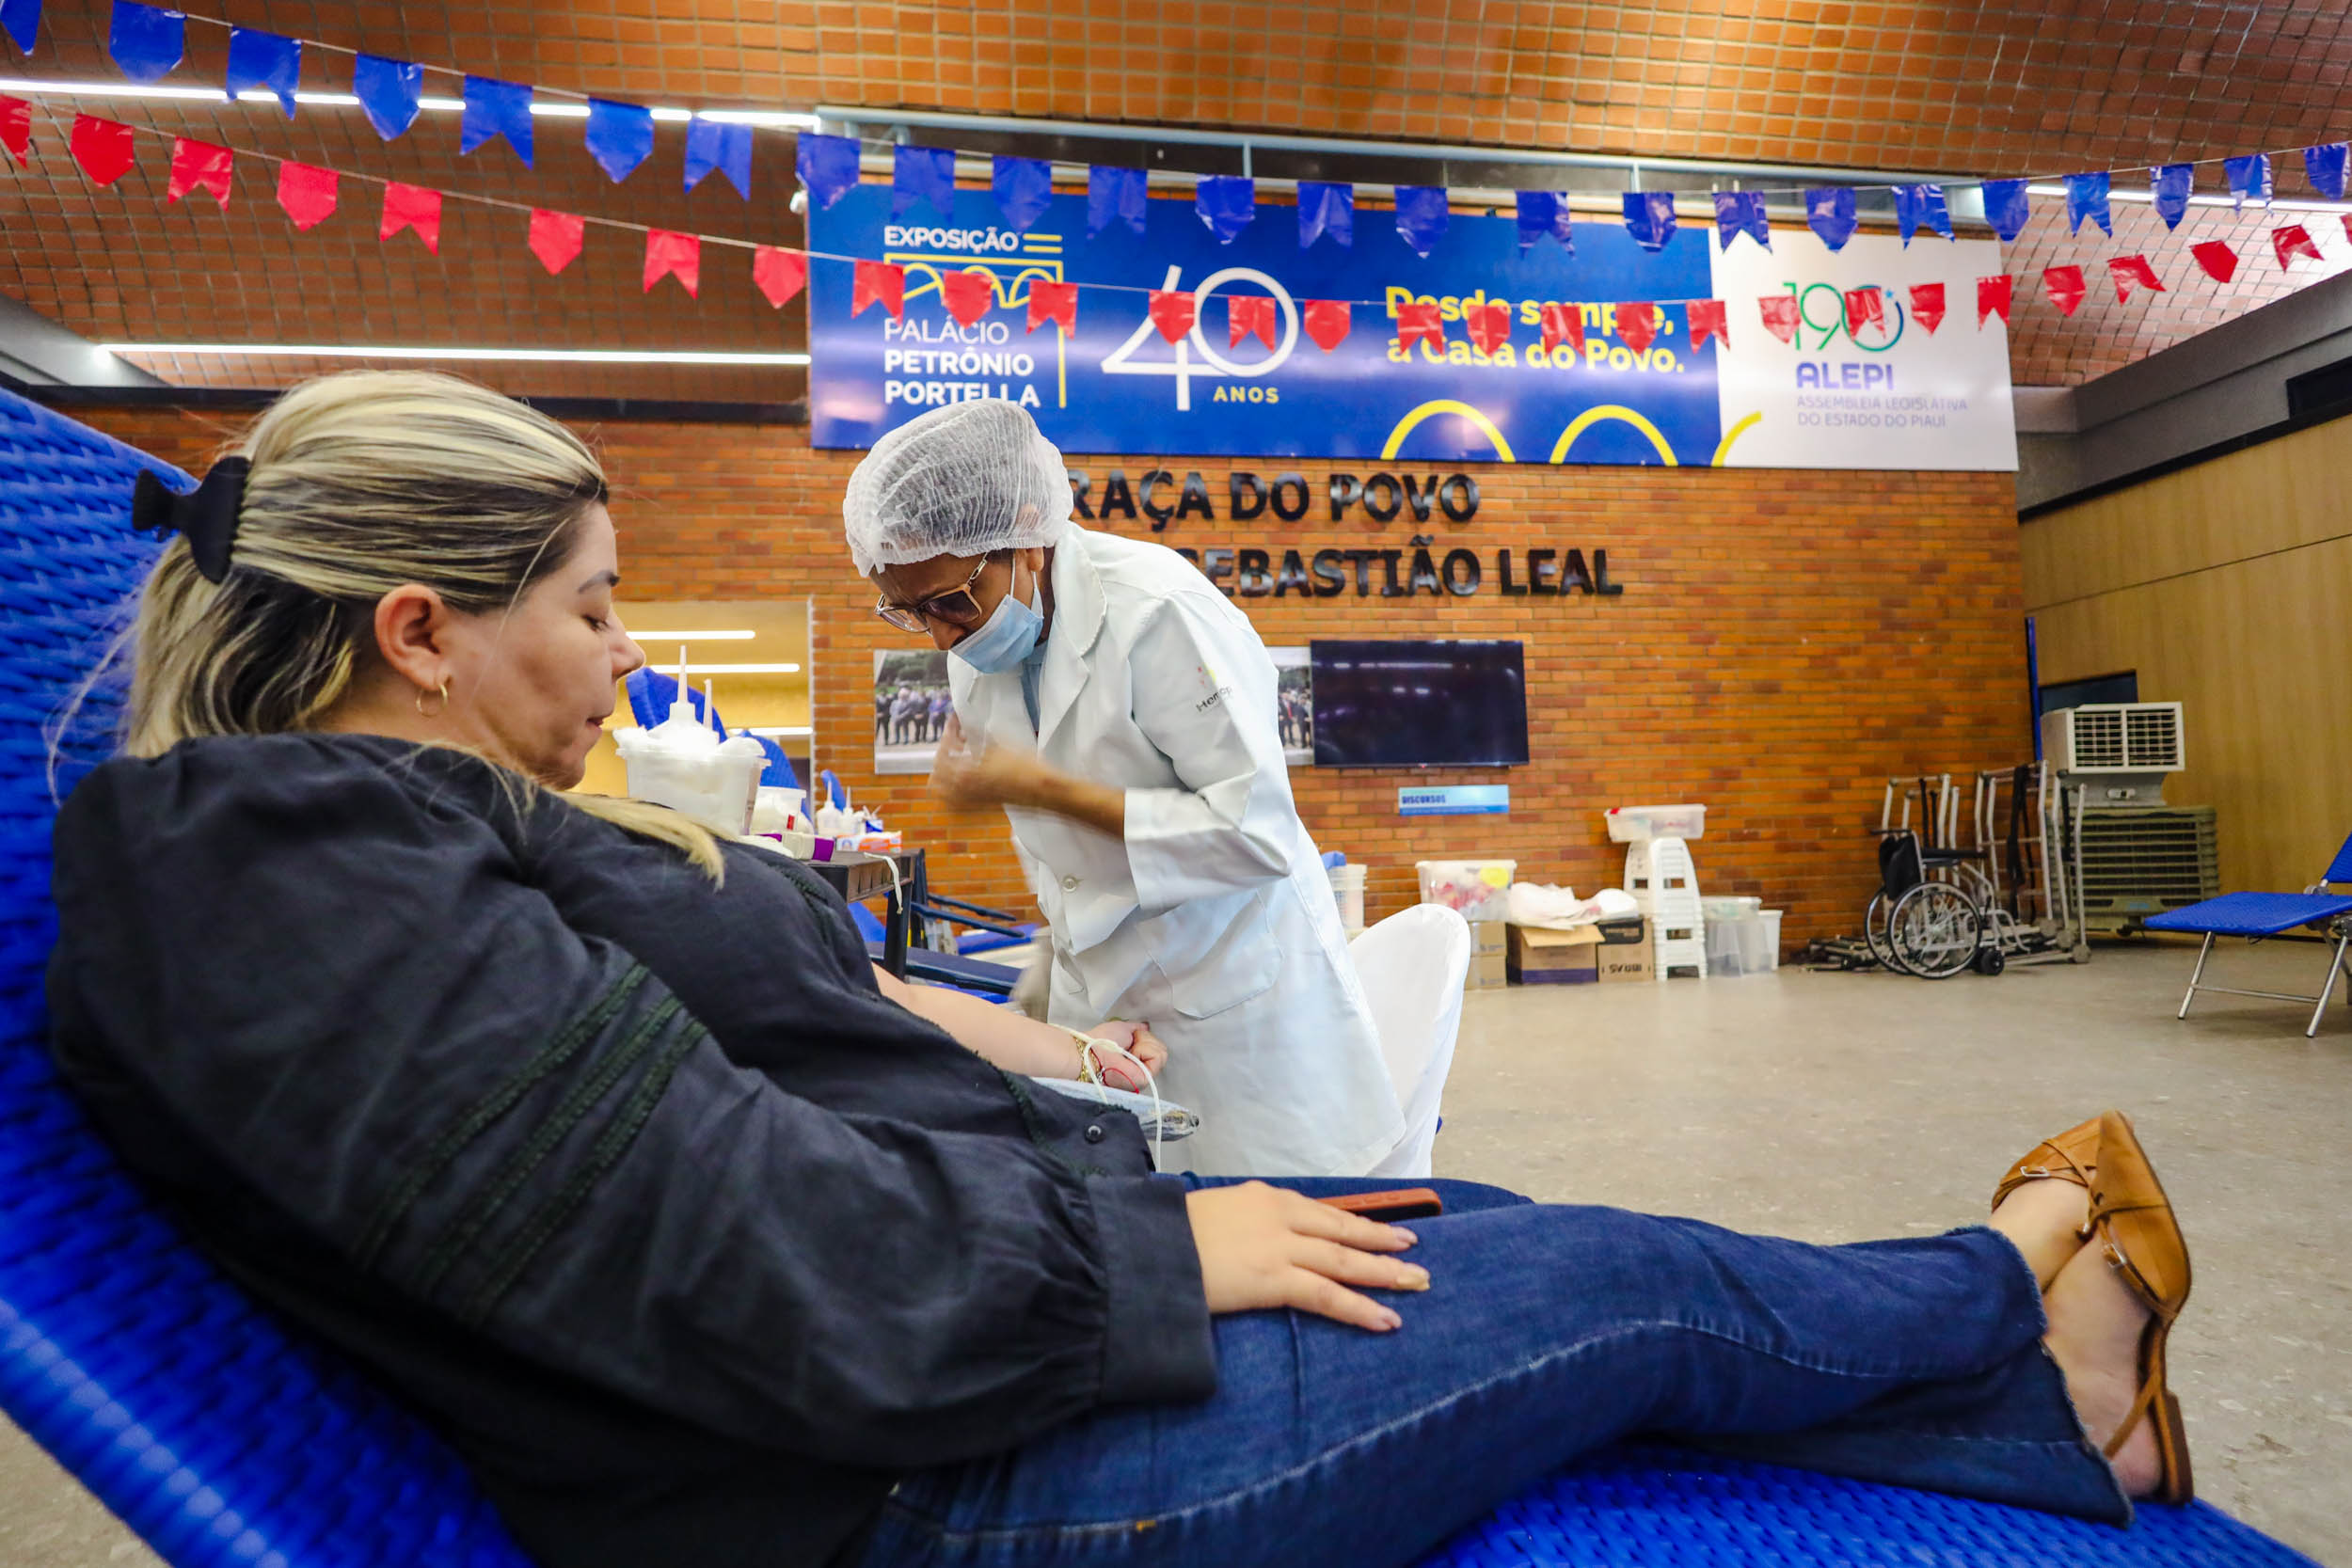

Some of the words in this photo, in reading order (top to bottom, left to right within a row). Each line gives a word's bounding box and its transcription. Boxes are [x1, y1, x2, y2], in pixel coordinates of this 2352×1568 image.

[884, 226, 1019, 254] EXPOSIÇÃO
[884, 314, 1009, 345] PALÁCIO
[1101, 265, 1299, 411] 40
[884, 346, 1034, 376] PETRÔNIO
[1388, 338, 1412, 363] a
[1525, 336, 1577, 370] do
[1796, 361, 1894, 390] ALEPI
[1214, 387, 1279, 403] ANOS
[1797, 395, 1881, 410] ASSEMBLEIA
[1885, 396, 1968, 411] LEGISLATIVA
[1798, 412, 1820, 426] DO
[1825, 412, 1881, 427] ESTADO
[1884, 413, 1907, 427] DO
[1068, 469, 1215, 532] RAÇA
[1231, 472, 1310, 522] DO
[1329, 472, 1481, 522] POVO
[1498, 548, 1624, 596] LEAL
